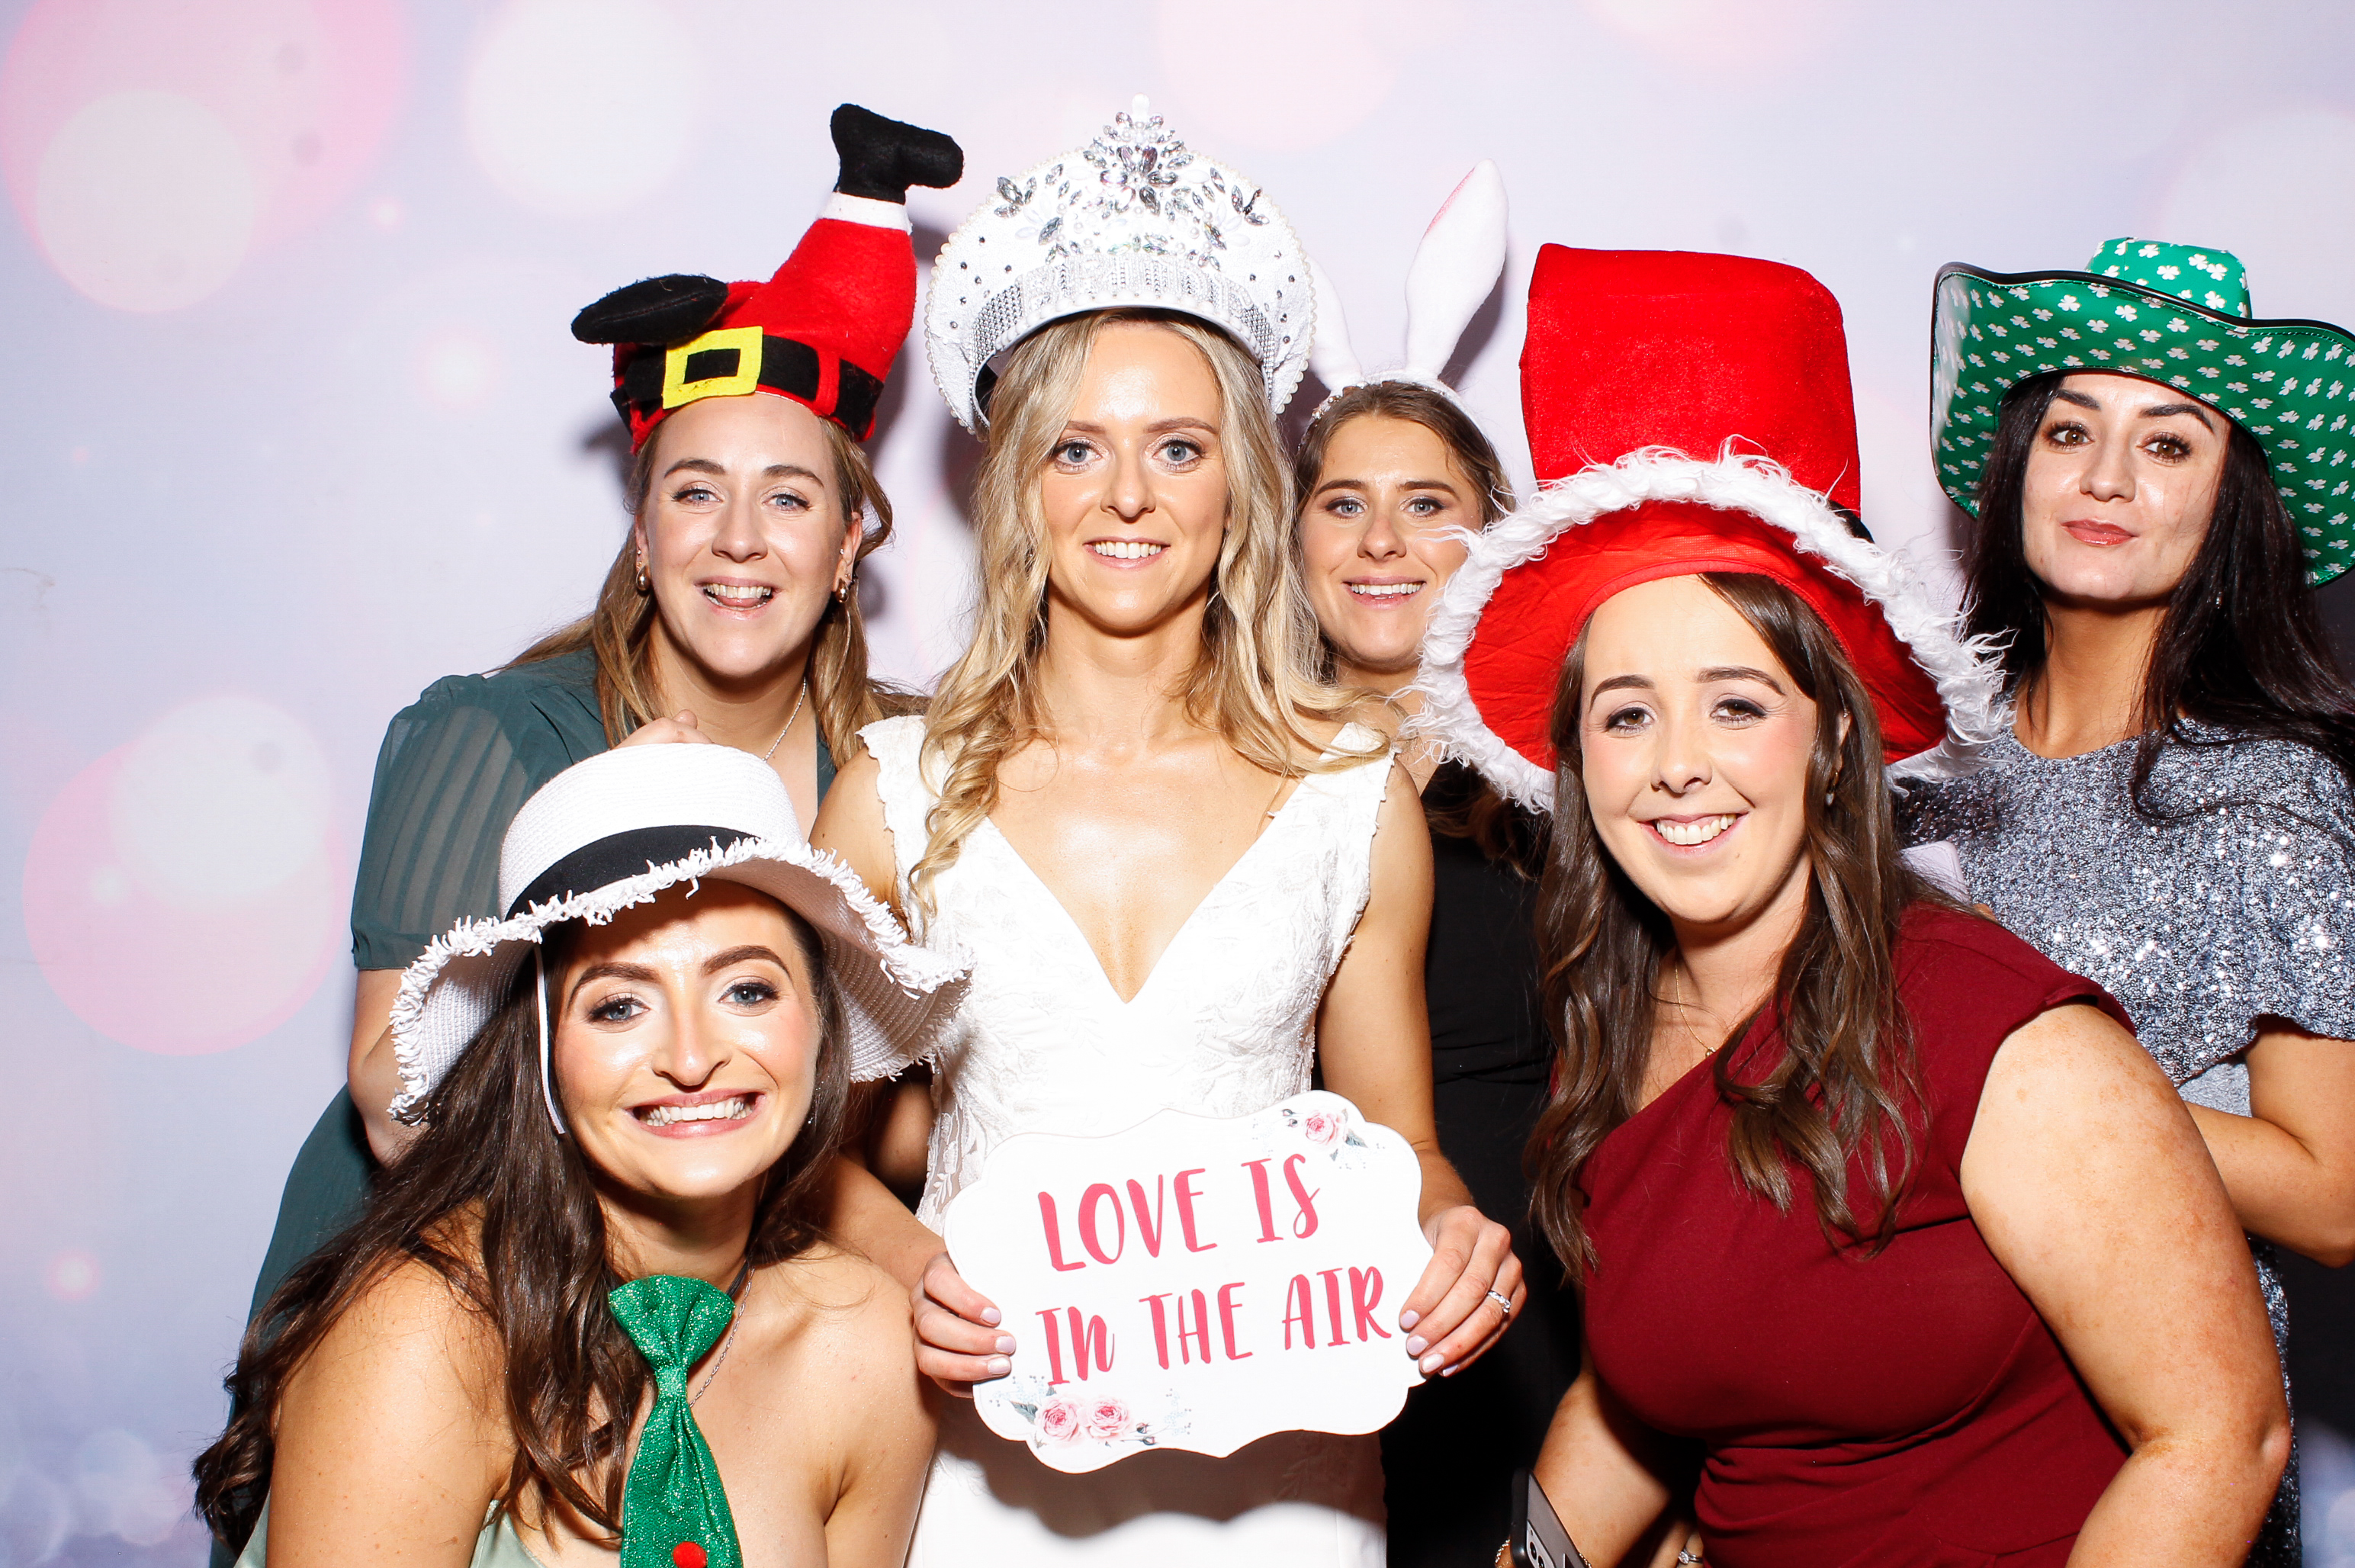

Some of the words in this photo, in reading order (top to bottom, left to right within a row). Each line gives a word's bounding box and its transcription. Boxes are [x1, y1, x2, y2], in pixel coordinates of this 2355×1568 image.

[1038, 1168, 1218, 1272] LOVE
[1241, 1153, 1321, 1244] IS
[1139, 1281, 1254, 1370] THE
[1281, 1266, 1393, 1351] AIR
